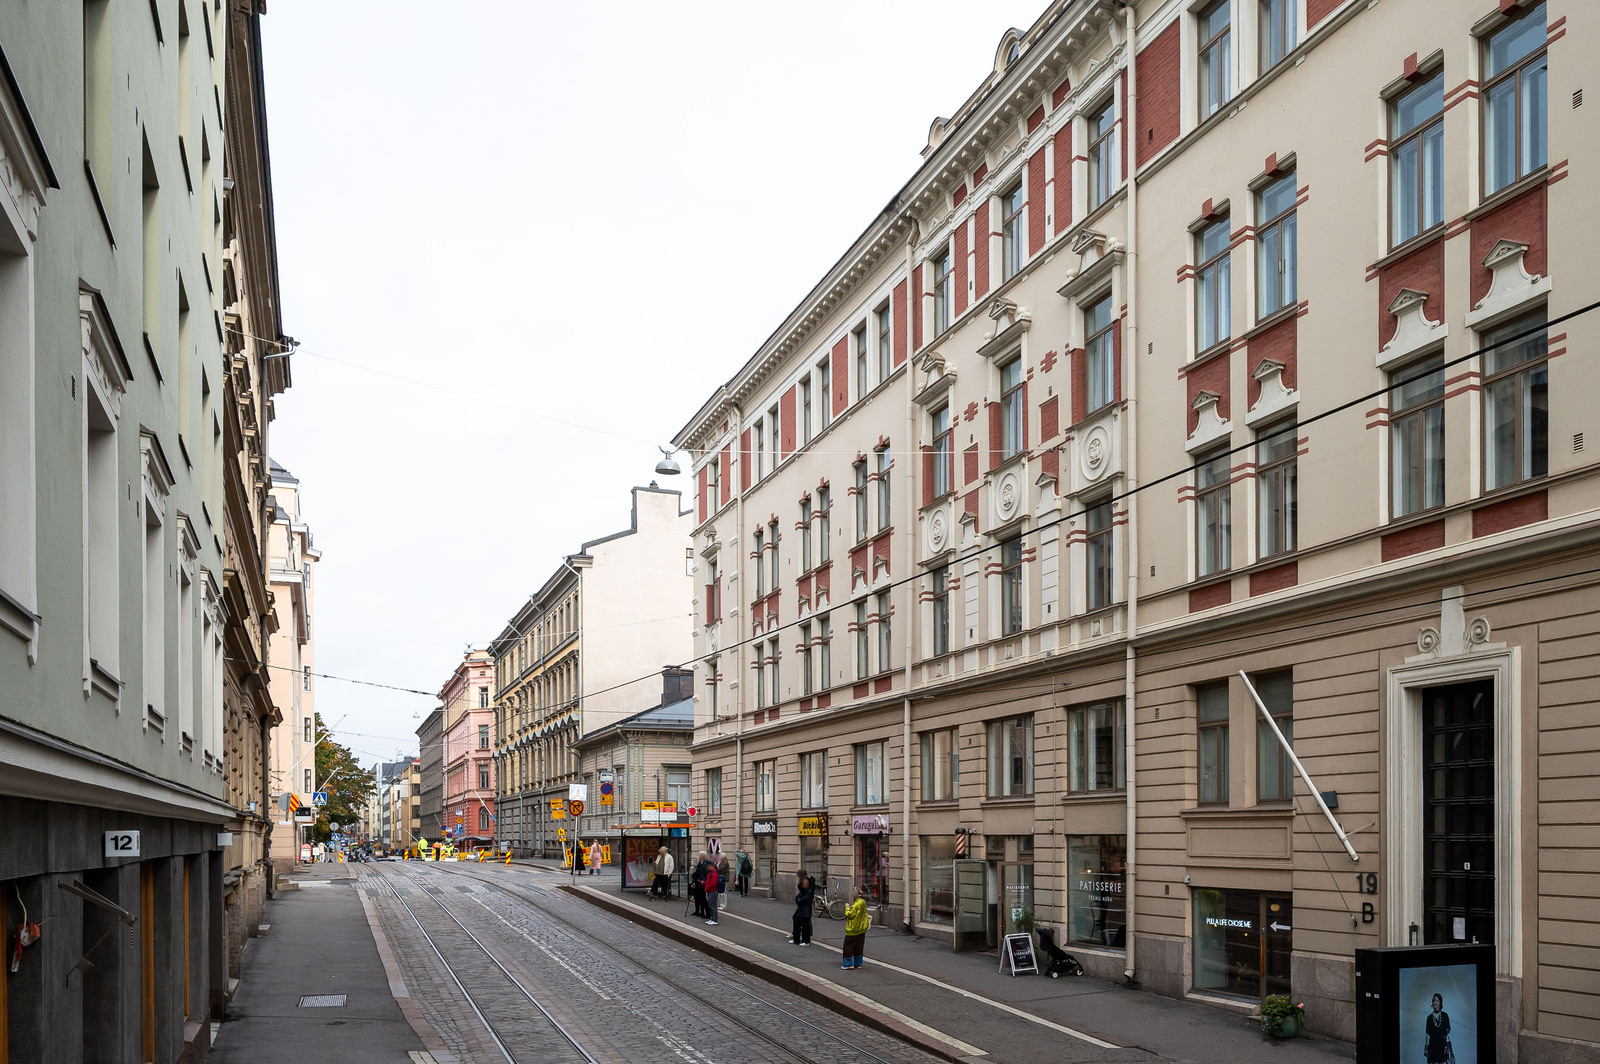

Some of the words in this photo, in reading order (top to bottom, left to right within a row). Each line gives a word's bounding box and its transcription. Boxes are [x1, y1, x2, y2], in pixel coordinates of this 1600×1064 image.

[110, 835, 132, 850] 12
[627, 839, 658, 851] LYKO
[1079, 880, 1122, 893] PATISSERIE
[1356, 872, 1377, 894] 19
[1362, 902, 1374, 923] B
[1219, 918, 1228, 926] LIFE
[1228, 919, 1243, 928] CHOSE
[1244, 920, 1252, 928] ME
